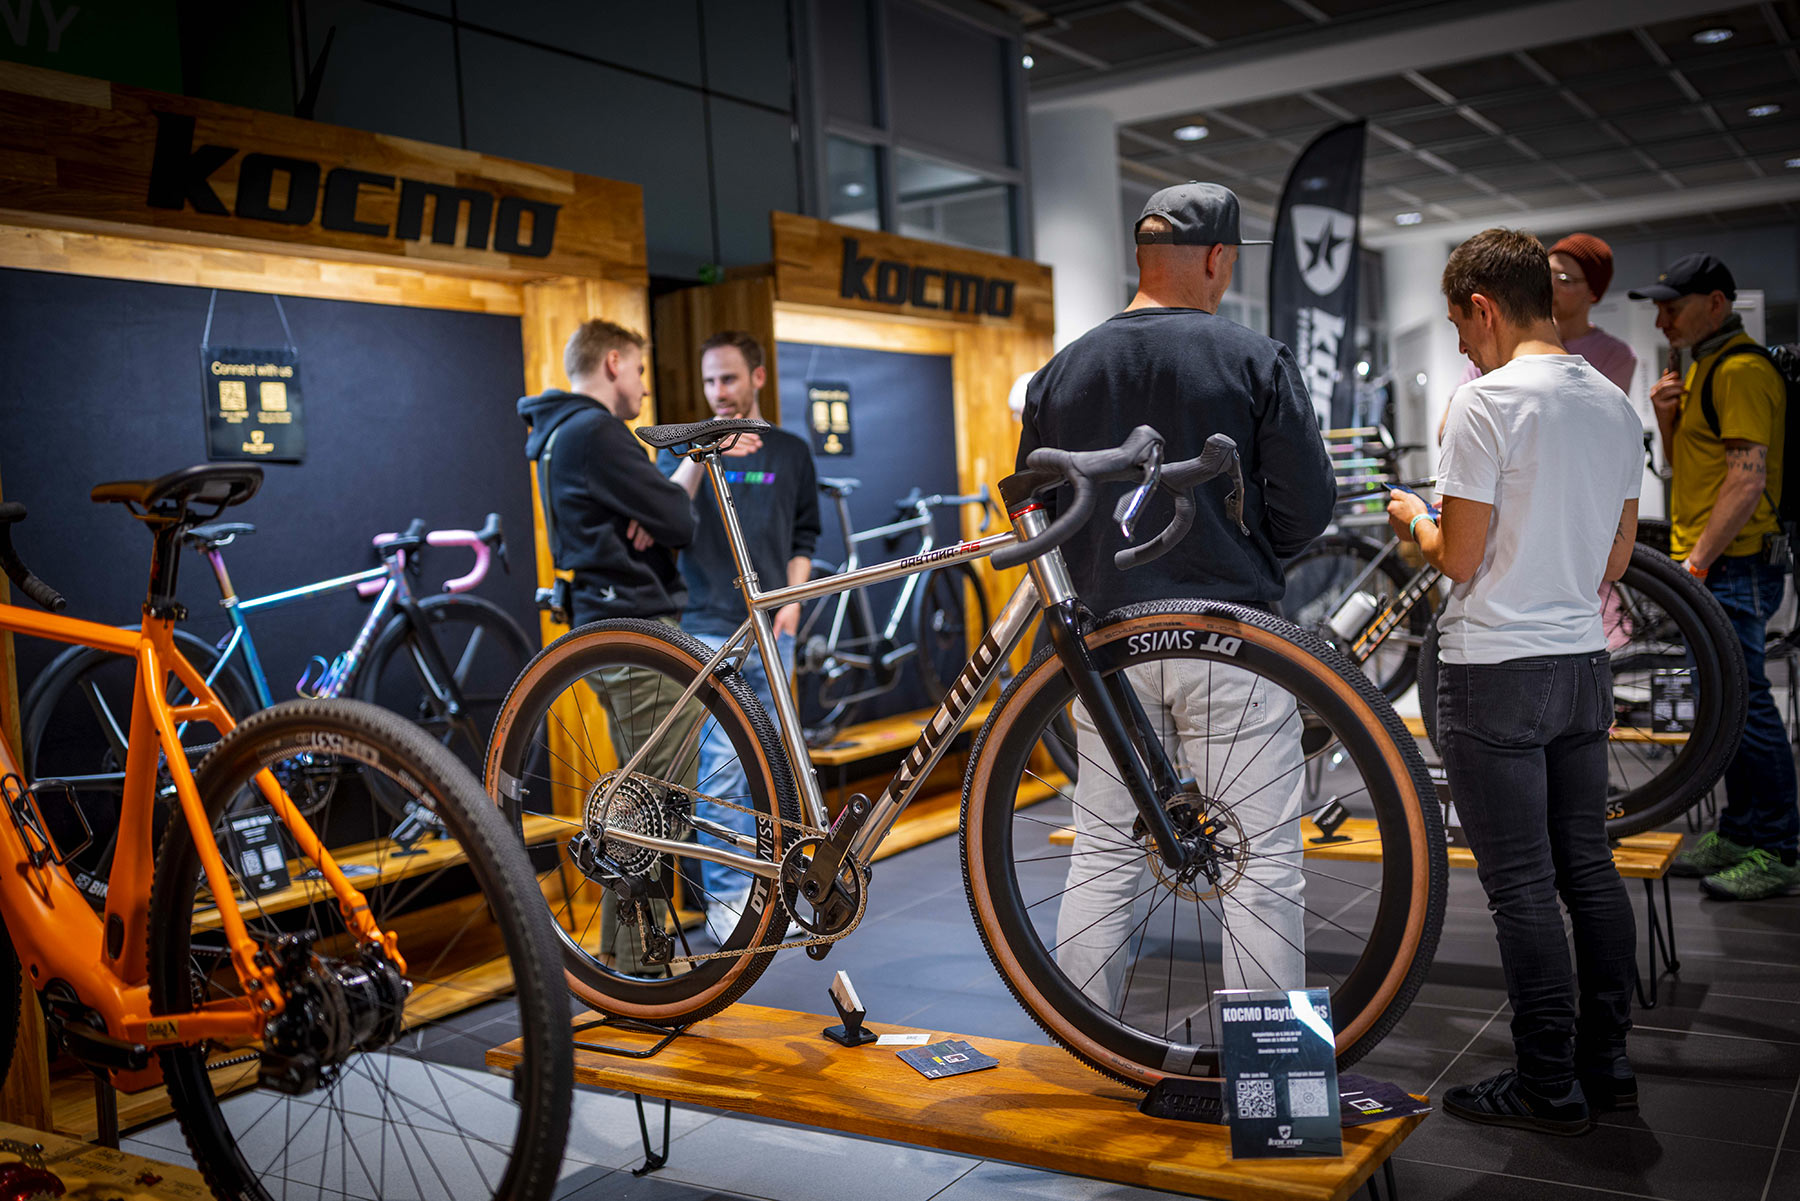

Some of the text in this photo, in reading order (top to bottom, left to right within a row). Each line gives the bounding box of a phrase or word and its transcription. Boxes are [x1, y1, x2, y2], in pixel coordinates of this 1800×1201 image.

[1127, 630, 1243, 657] DT SWISS
[750, 877, 768, 916] DT
[1223, 1006, 1262, 1022] KOCMO
[1264, 1005, 1299, 1022] Dayto
